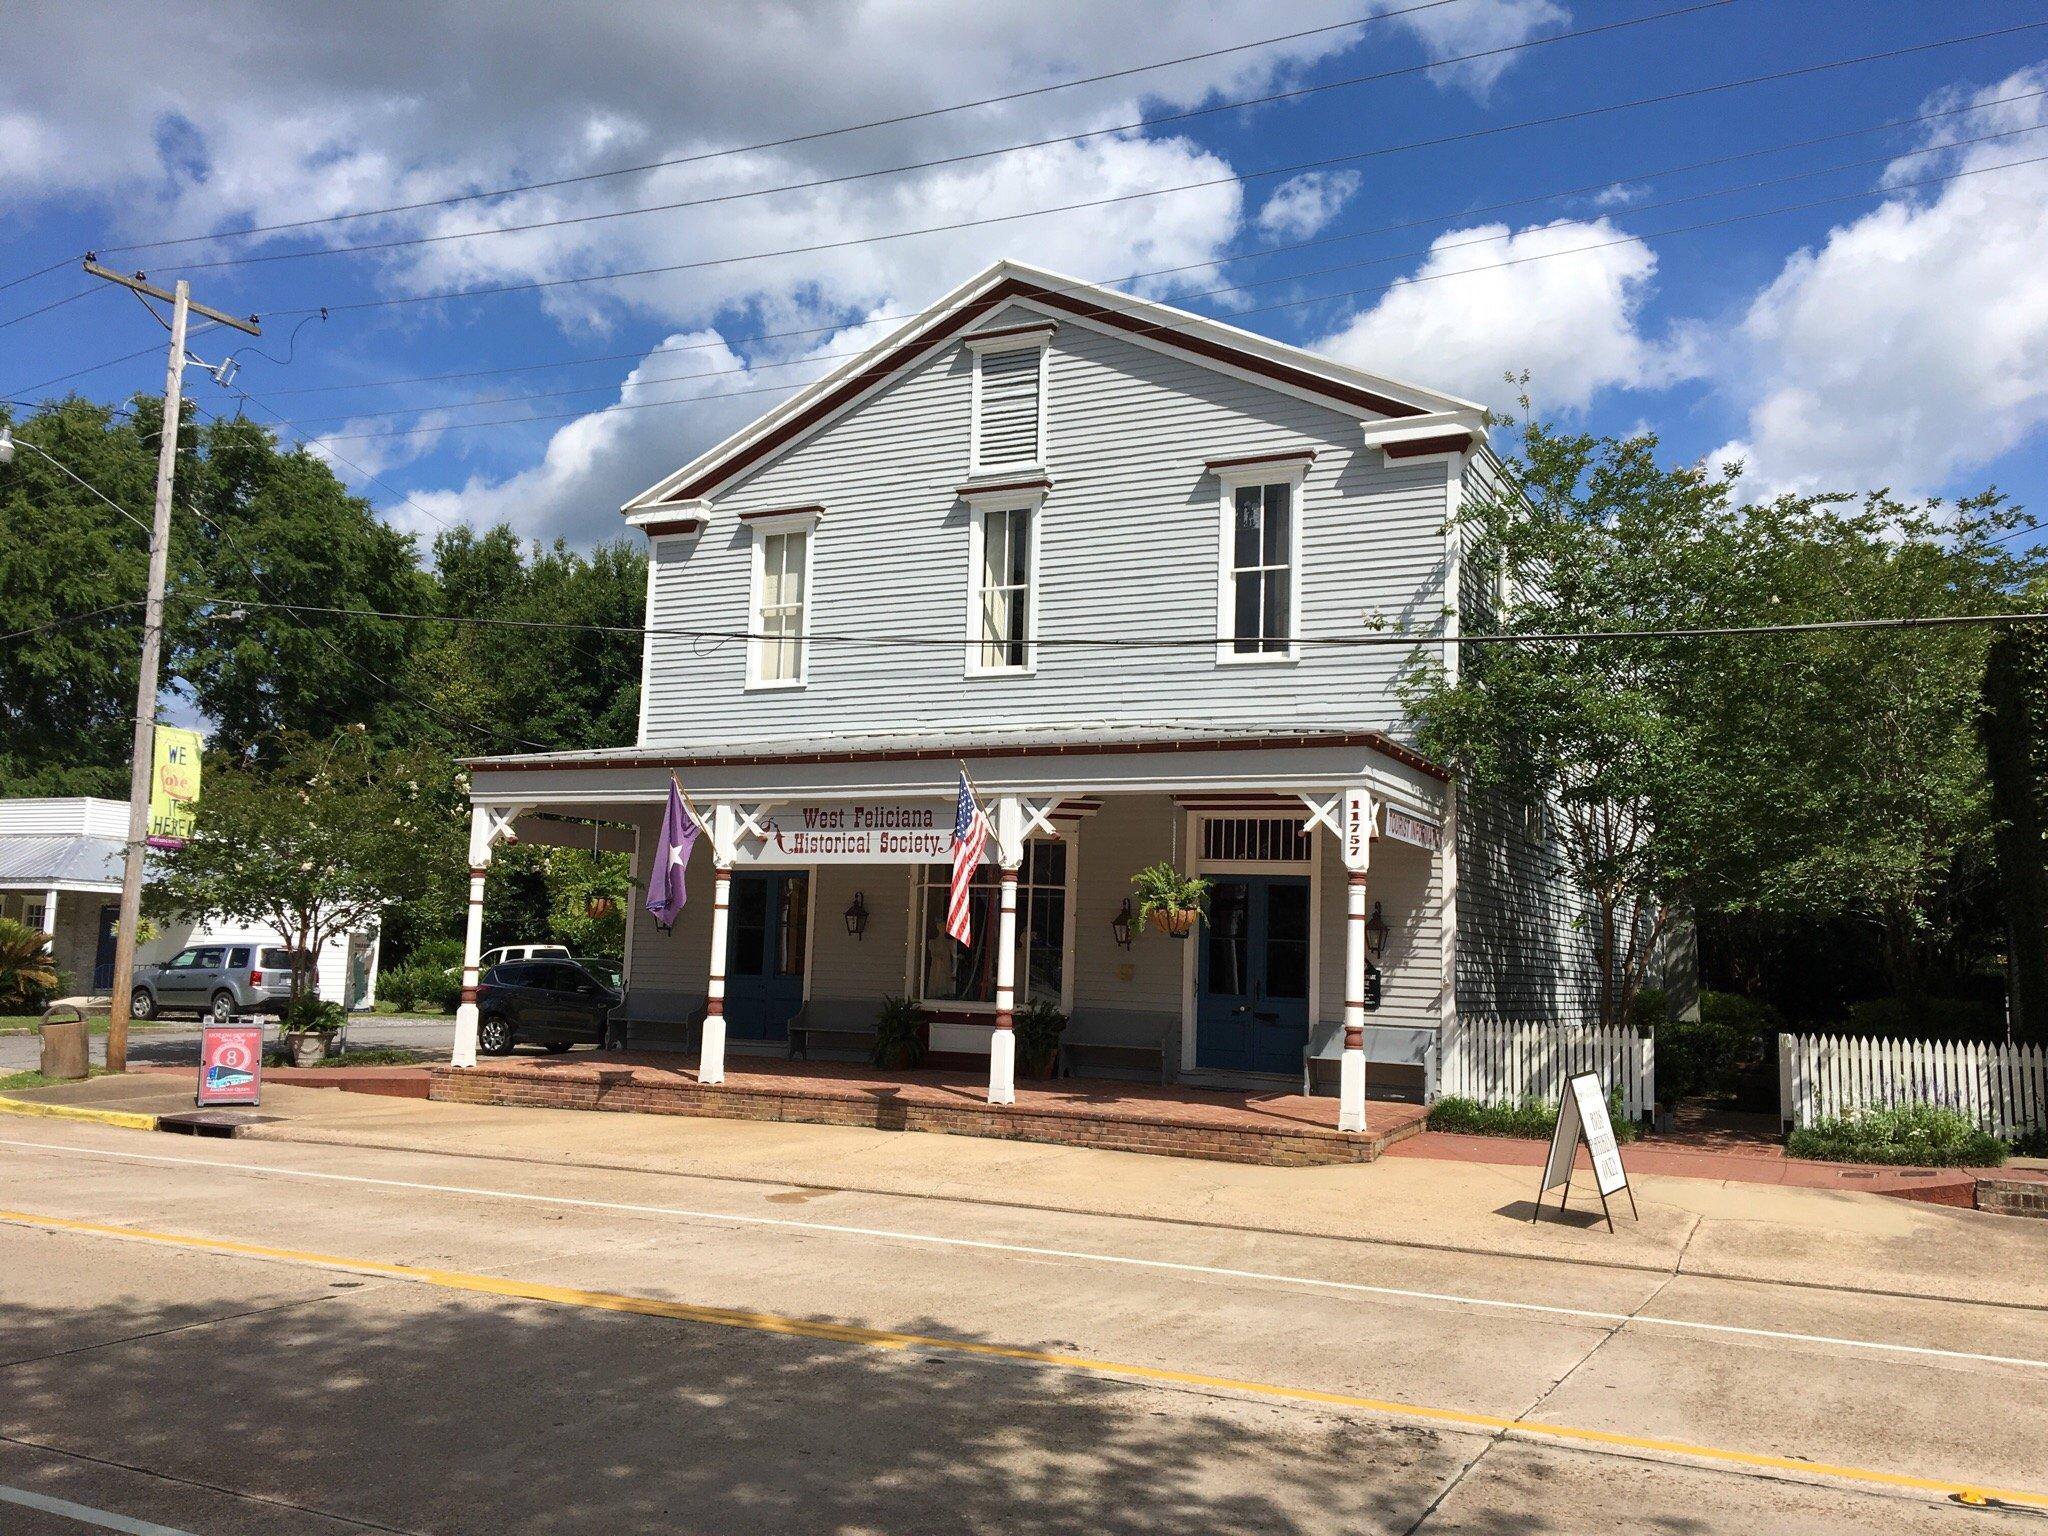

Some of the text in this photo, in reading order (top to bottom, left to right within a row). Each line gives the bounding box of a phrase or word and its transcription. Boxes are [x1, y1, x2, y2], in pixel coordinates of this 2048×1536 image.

[168, 745, 187, 766] WE
[153, 815, 192, 838] HERE!
[802, 806, 934, 829] West Feliciana
[1349, 800, 1360, 856] 11757
[793, 832, 940, 857] Historical Society
[226, 1050, 237, 1066] 8
